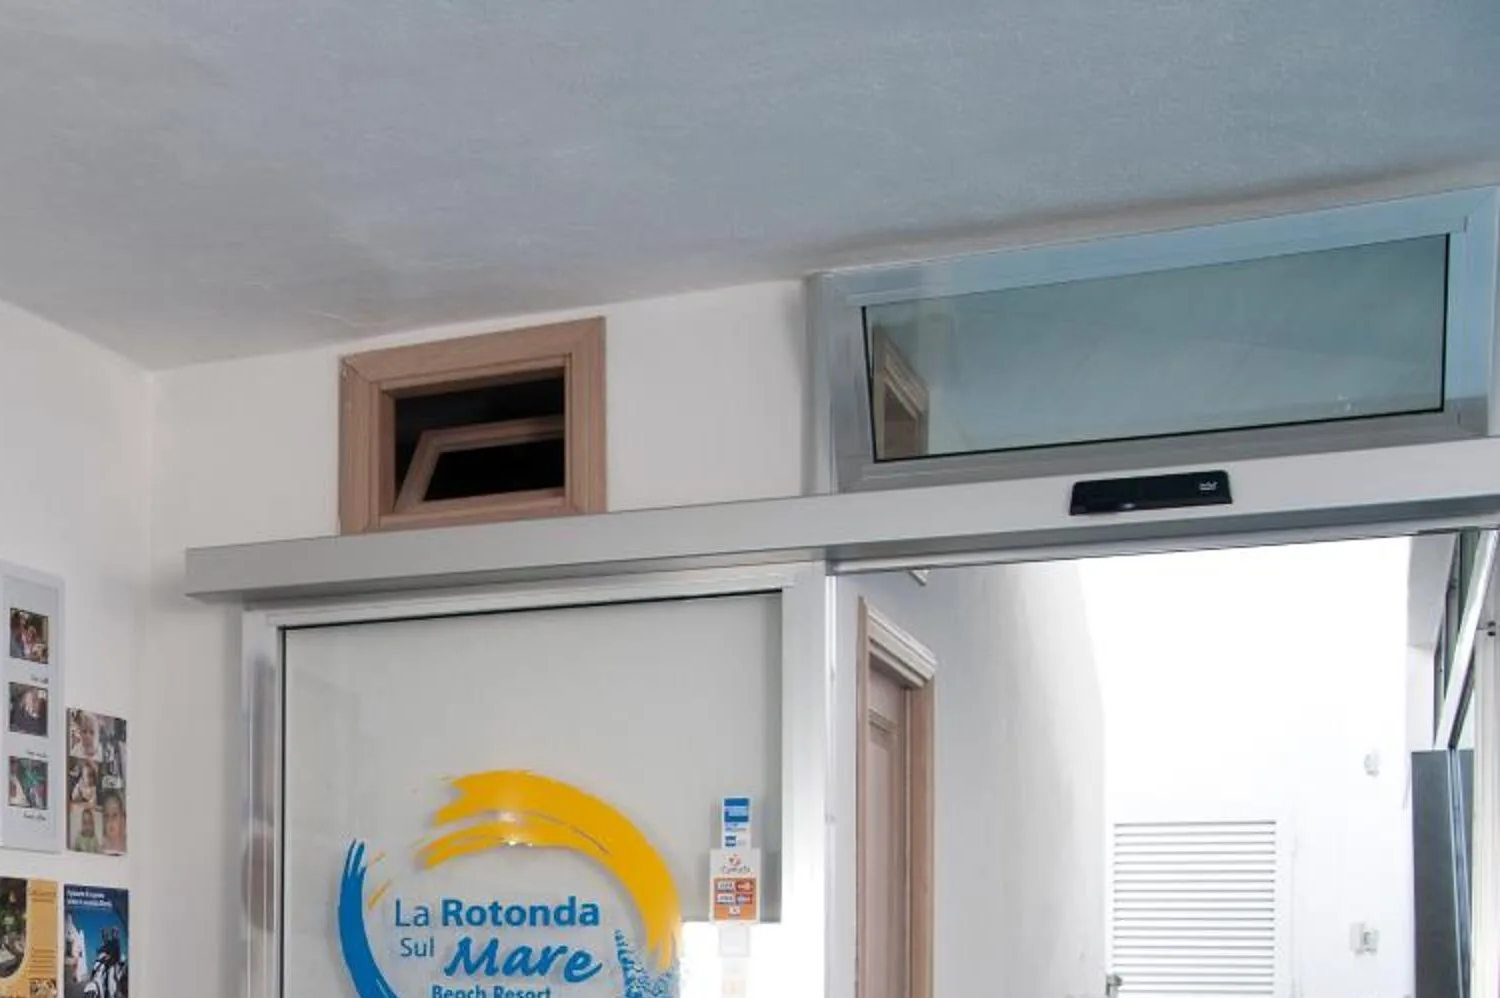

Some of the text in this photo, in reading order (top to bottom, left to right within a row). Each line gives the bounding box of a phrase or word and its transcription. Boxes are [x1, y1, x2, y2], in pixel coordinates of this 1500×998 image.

[395, 896, 600, 927] La Rotonda
[400, 935, 604, 983] Sul Mare
